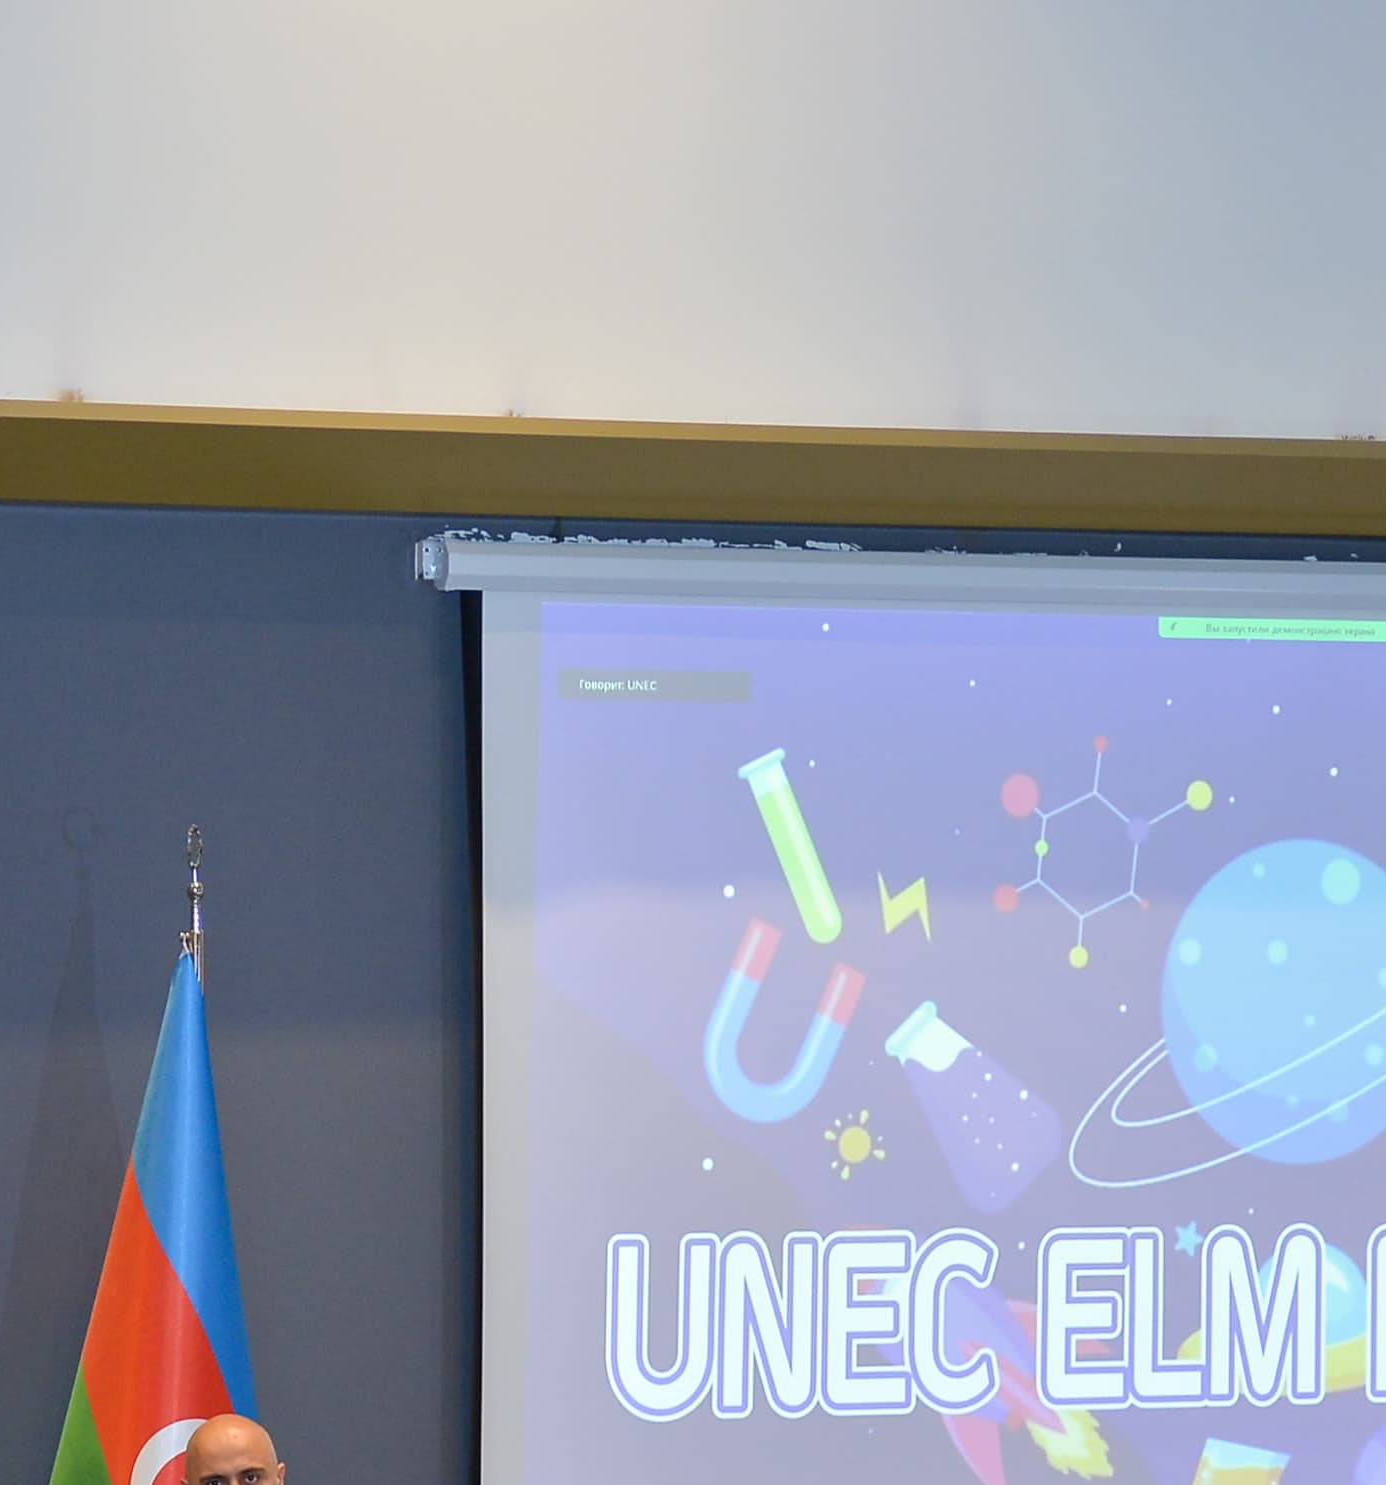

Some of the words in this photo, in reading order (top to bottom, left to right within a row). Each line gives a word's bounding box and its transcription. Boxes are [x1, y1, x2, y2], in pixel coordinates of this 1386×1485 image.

[627, 679, 658, 692] UNEC
[606, 1227, 1000, 1423] UNEC
[1035, 1221, 1328, 1410] ELM
